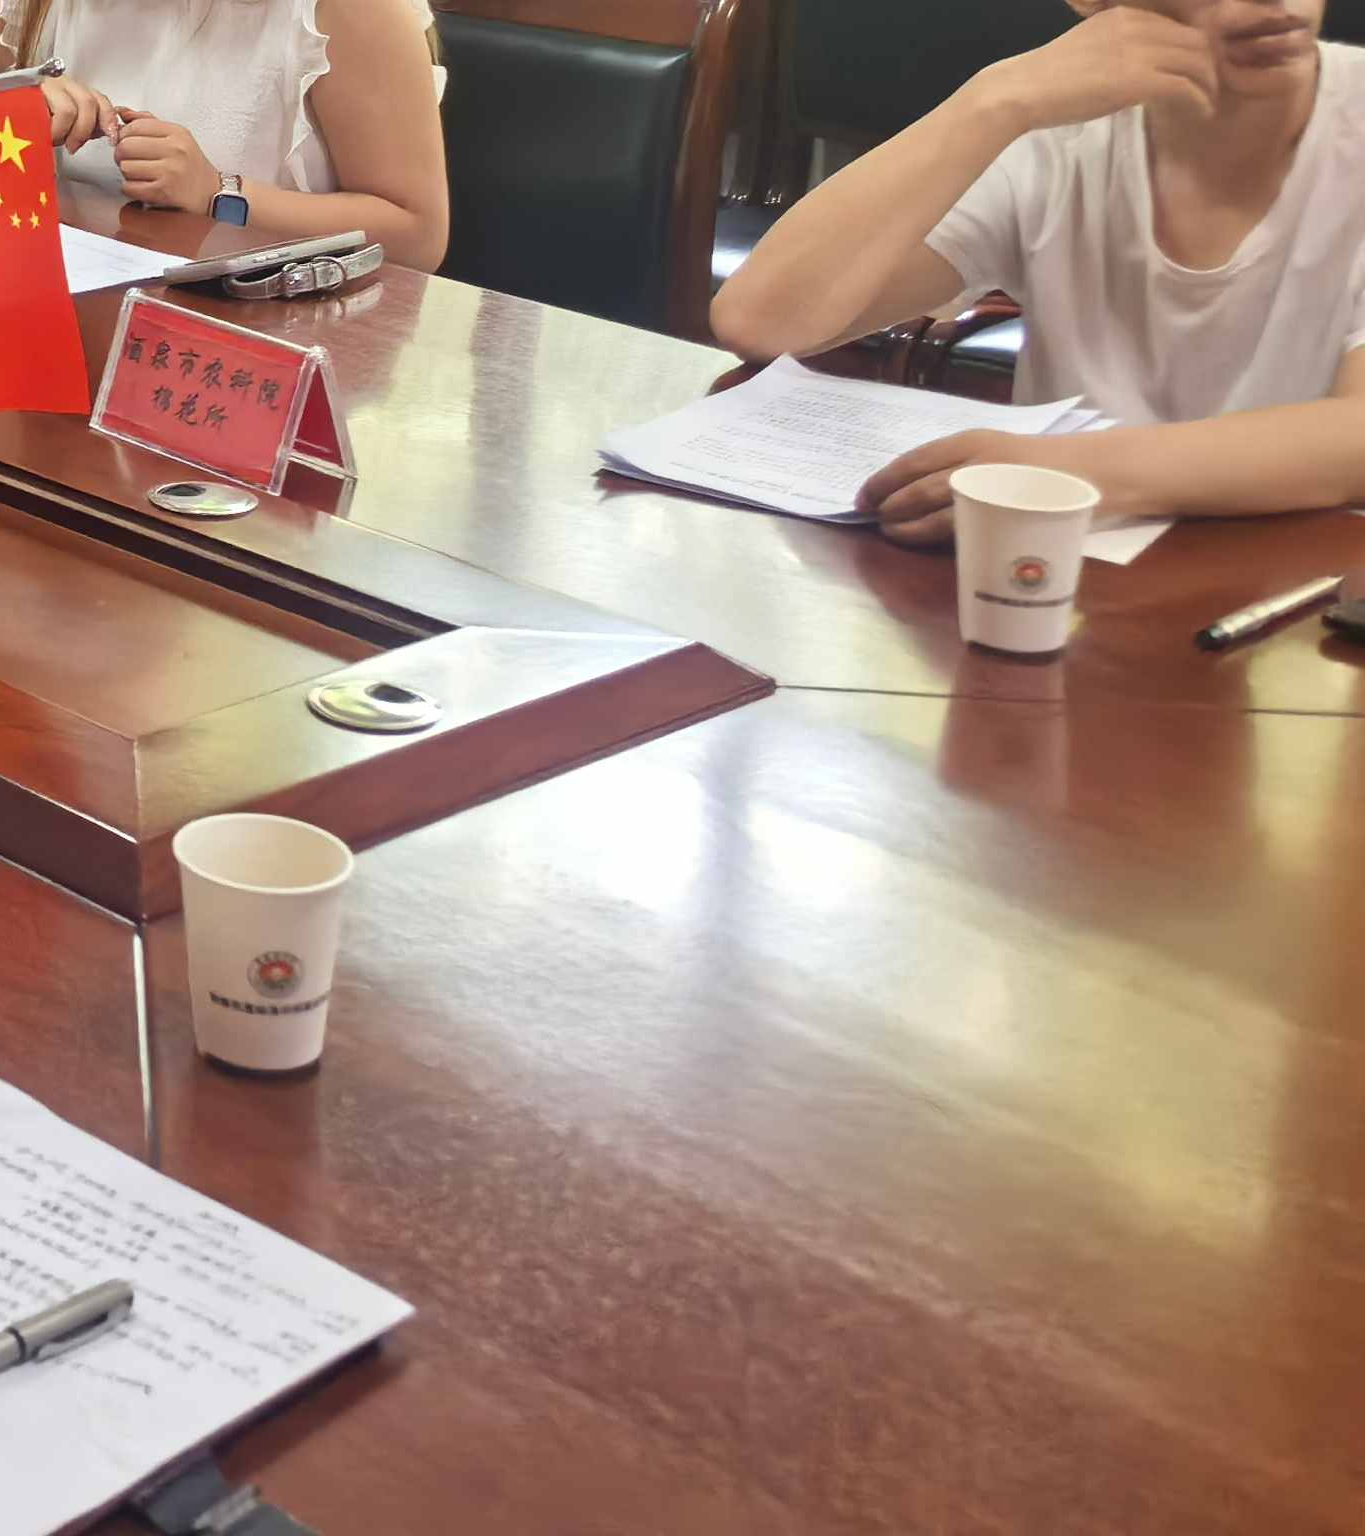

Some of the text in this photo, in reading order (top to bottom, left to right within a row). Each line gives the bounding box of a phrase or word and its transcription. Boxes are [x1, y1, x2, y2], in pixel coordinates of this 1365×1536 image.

[127, 331, 281, 411] 酒泉市农科院
